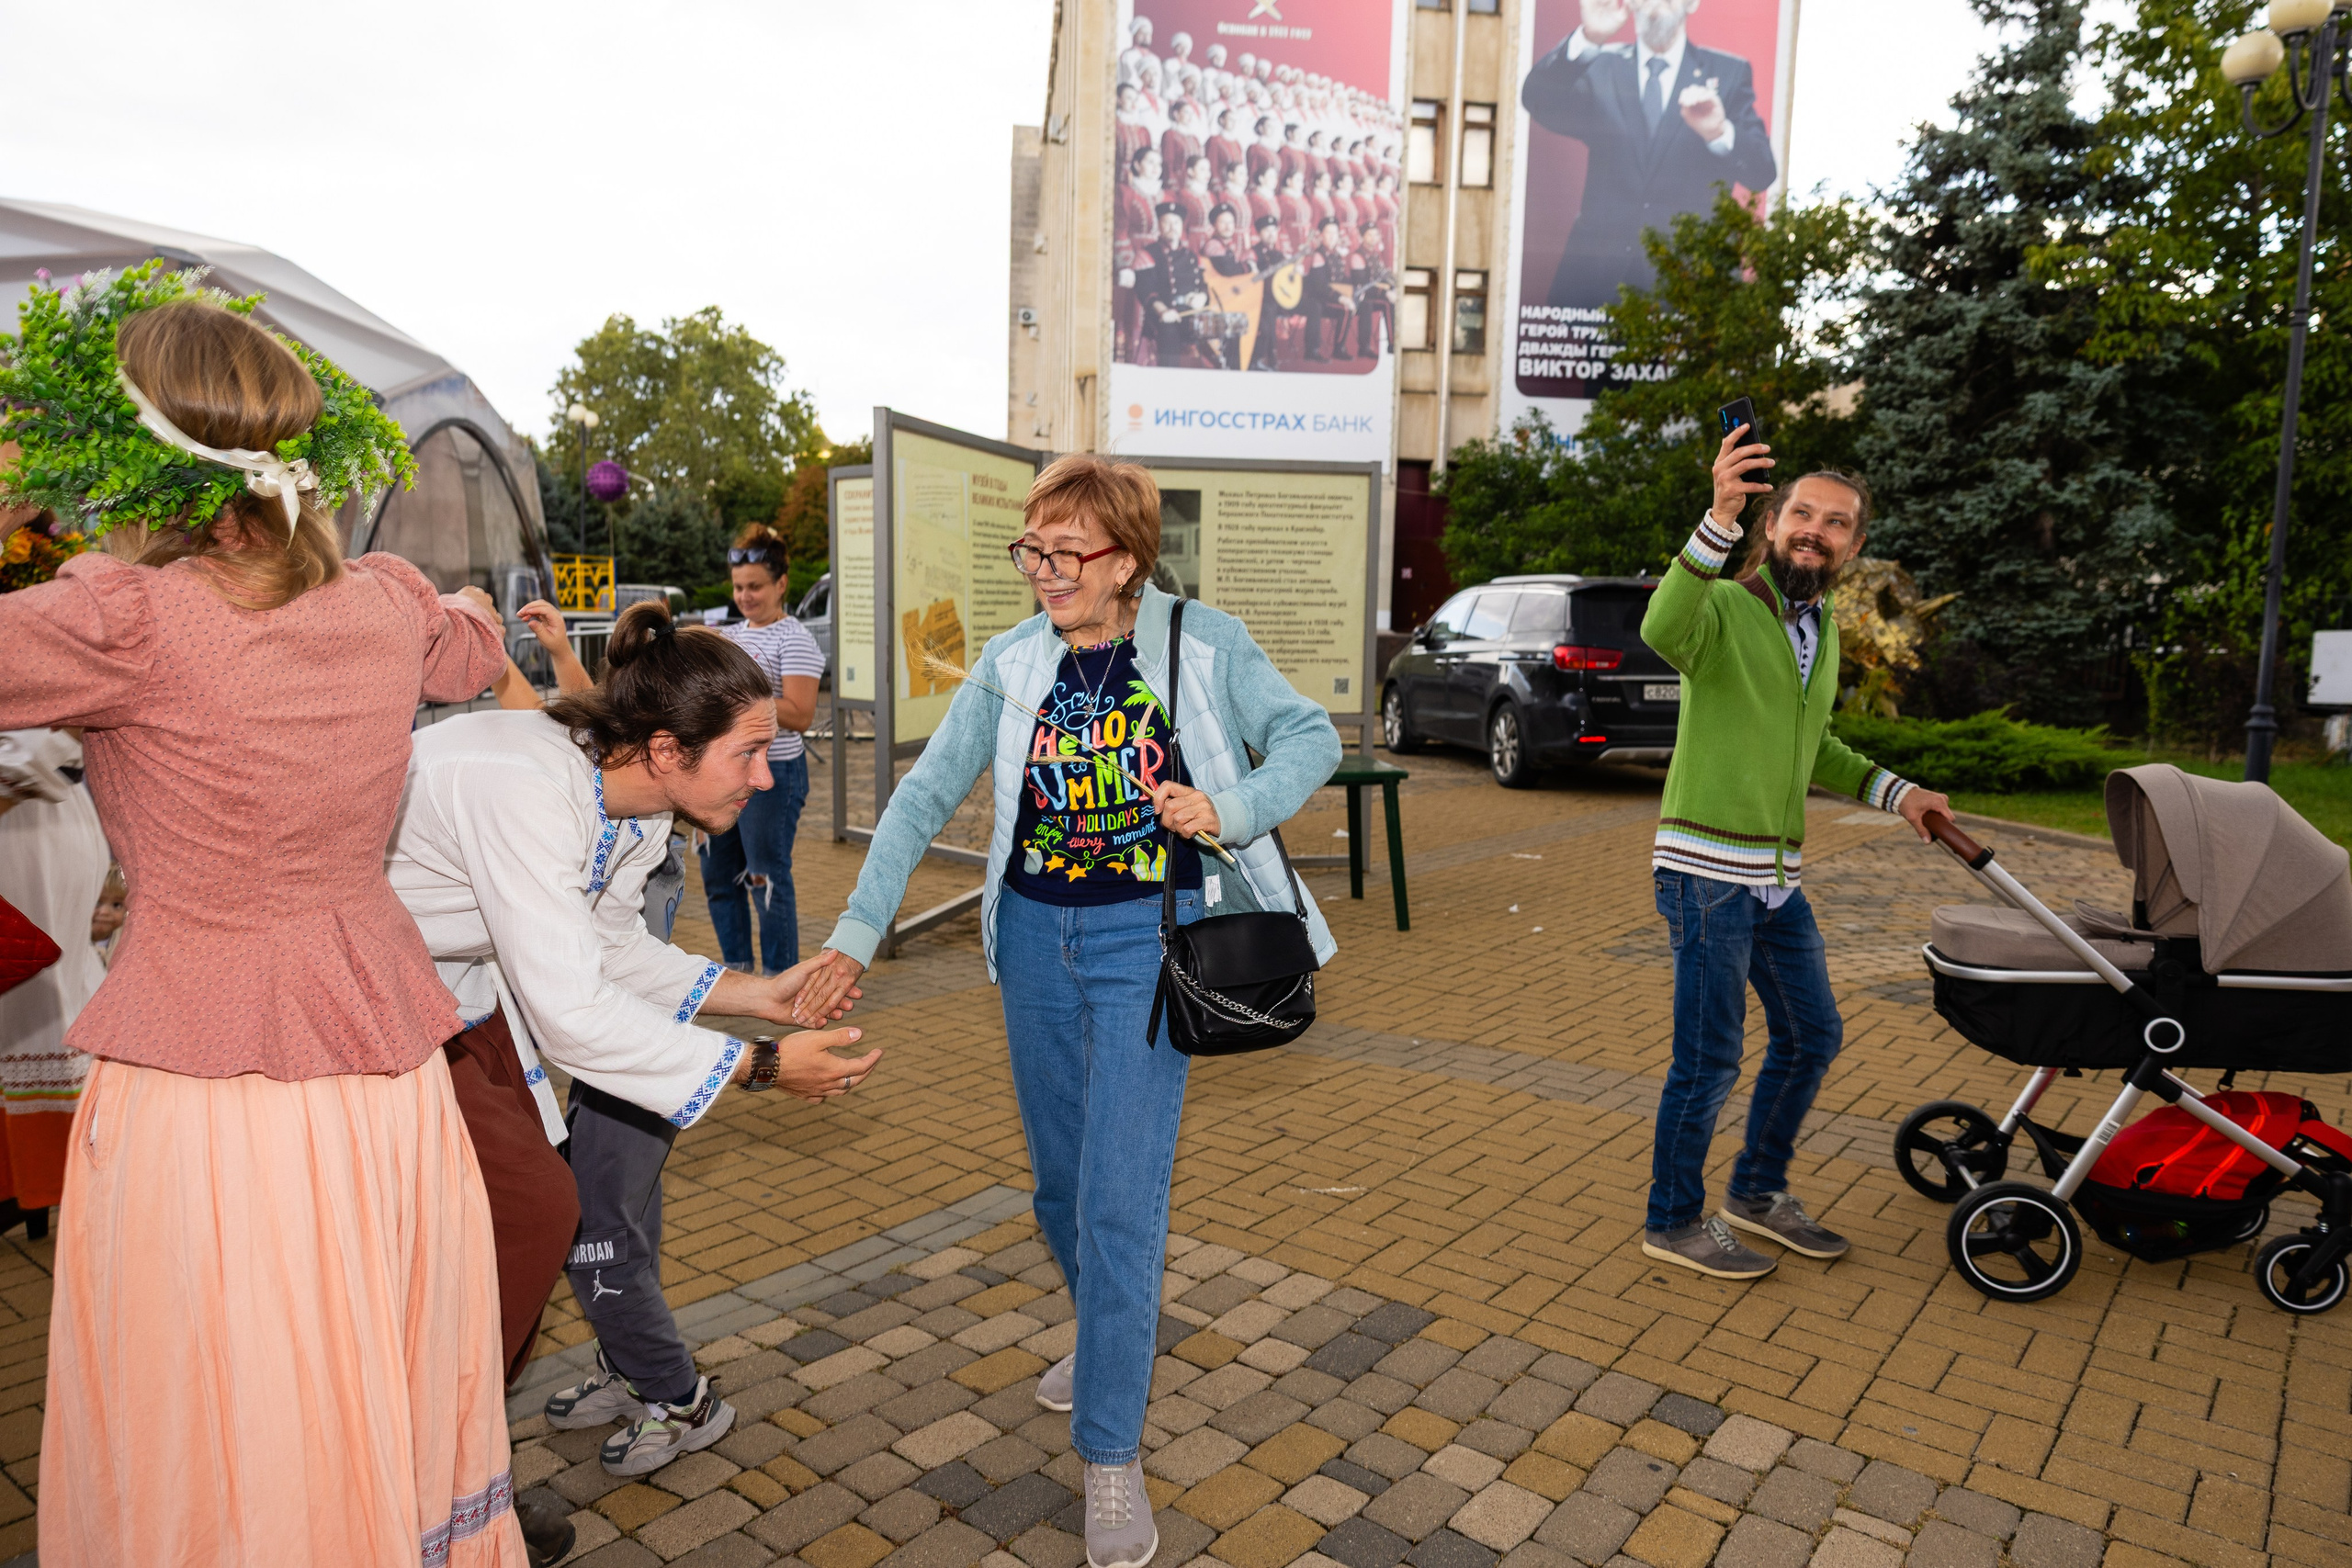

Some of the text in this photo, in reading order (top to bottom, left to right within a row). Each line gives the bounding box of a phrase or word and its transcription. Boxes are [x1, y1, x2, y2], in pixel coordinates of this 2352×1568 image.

[1519, 322, 1569, 339] ГЕРОЙ
[1517, 341, 1588, 359] ДВАЖДЫ
[1518, 357, 1606, 380] ВИКТОР
[1154, 409, 1373, 434] ИНГОССТРАХ БАНК
[1038, 682, 1115, 731] Say
[1069, 761, 1088, 773] to
[1076, 807, 1139, 834] HOLIDAYS
[1035, 817, 1157, 856] enjoy every moment
